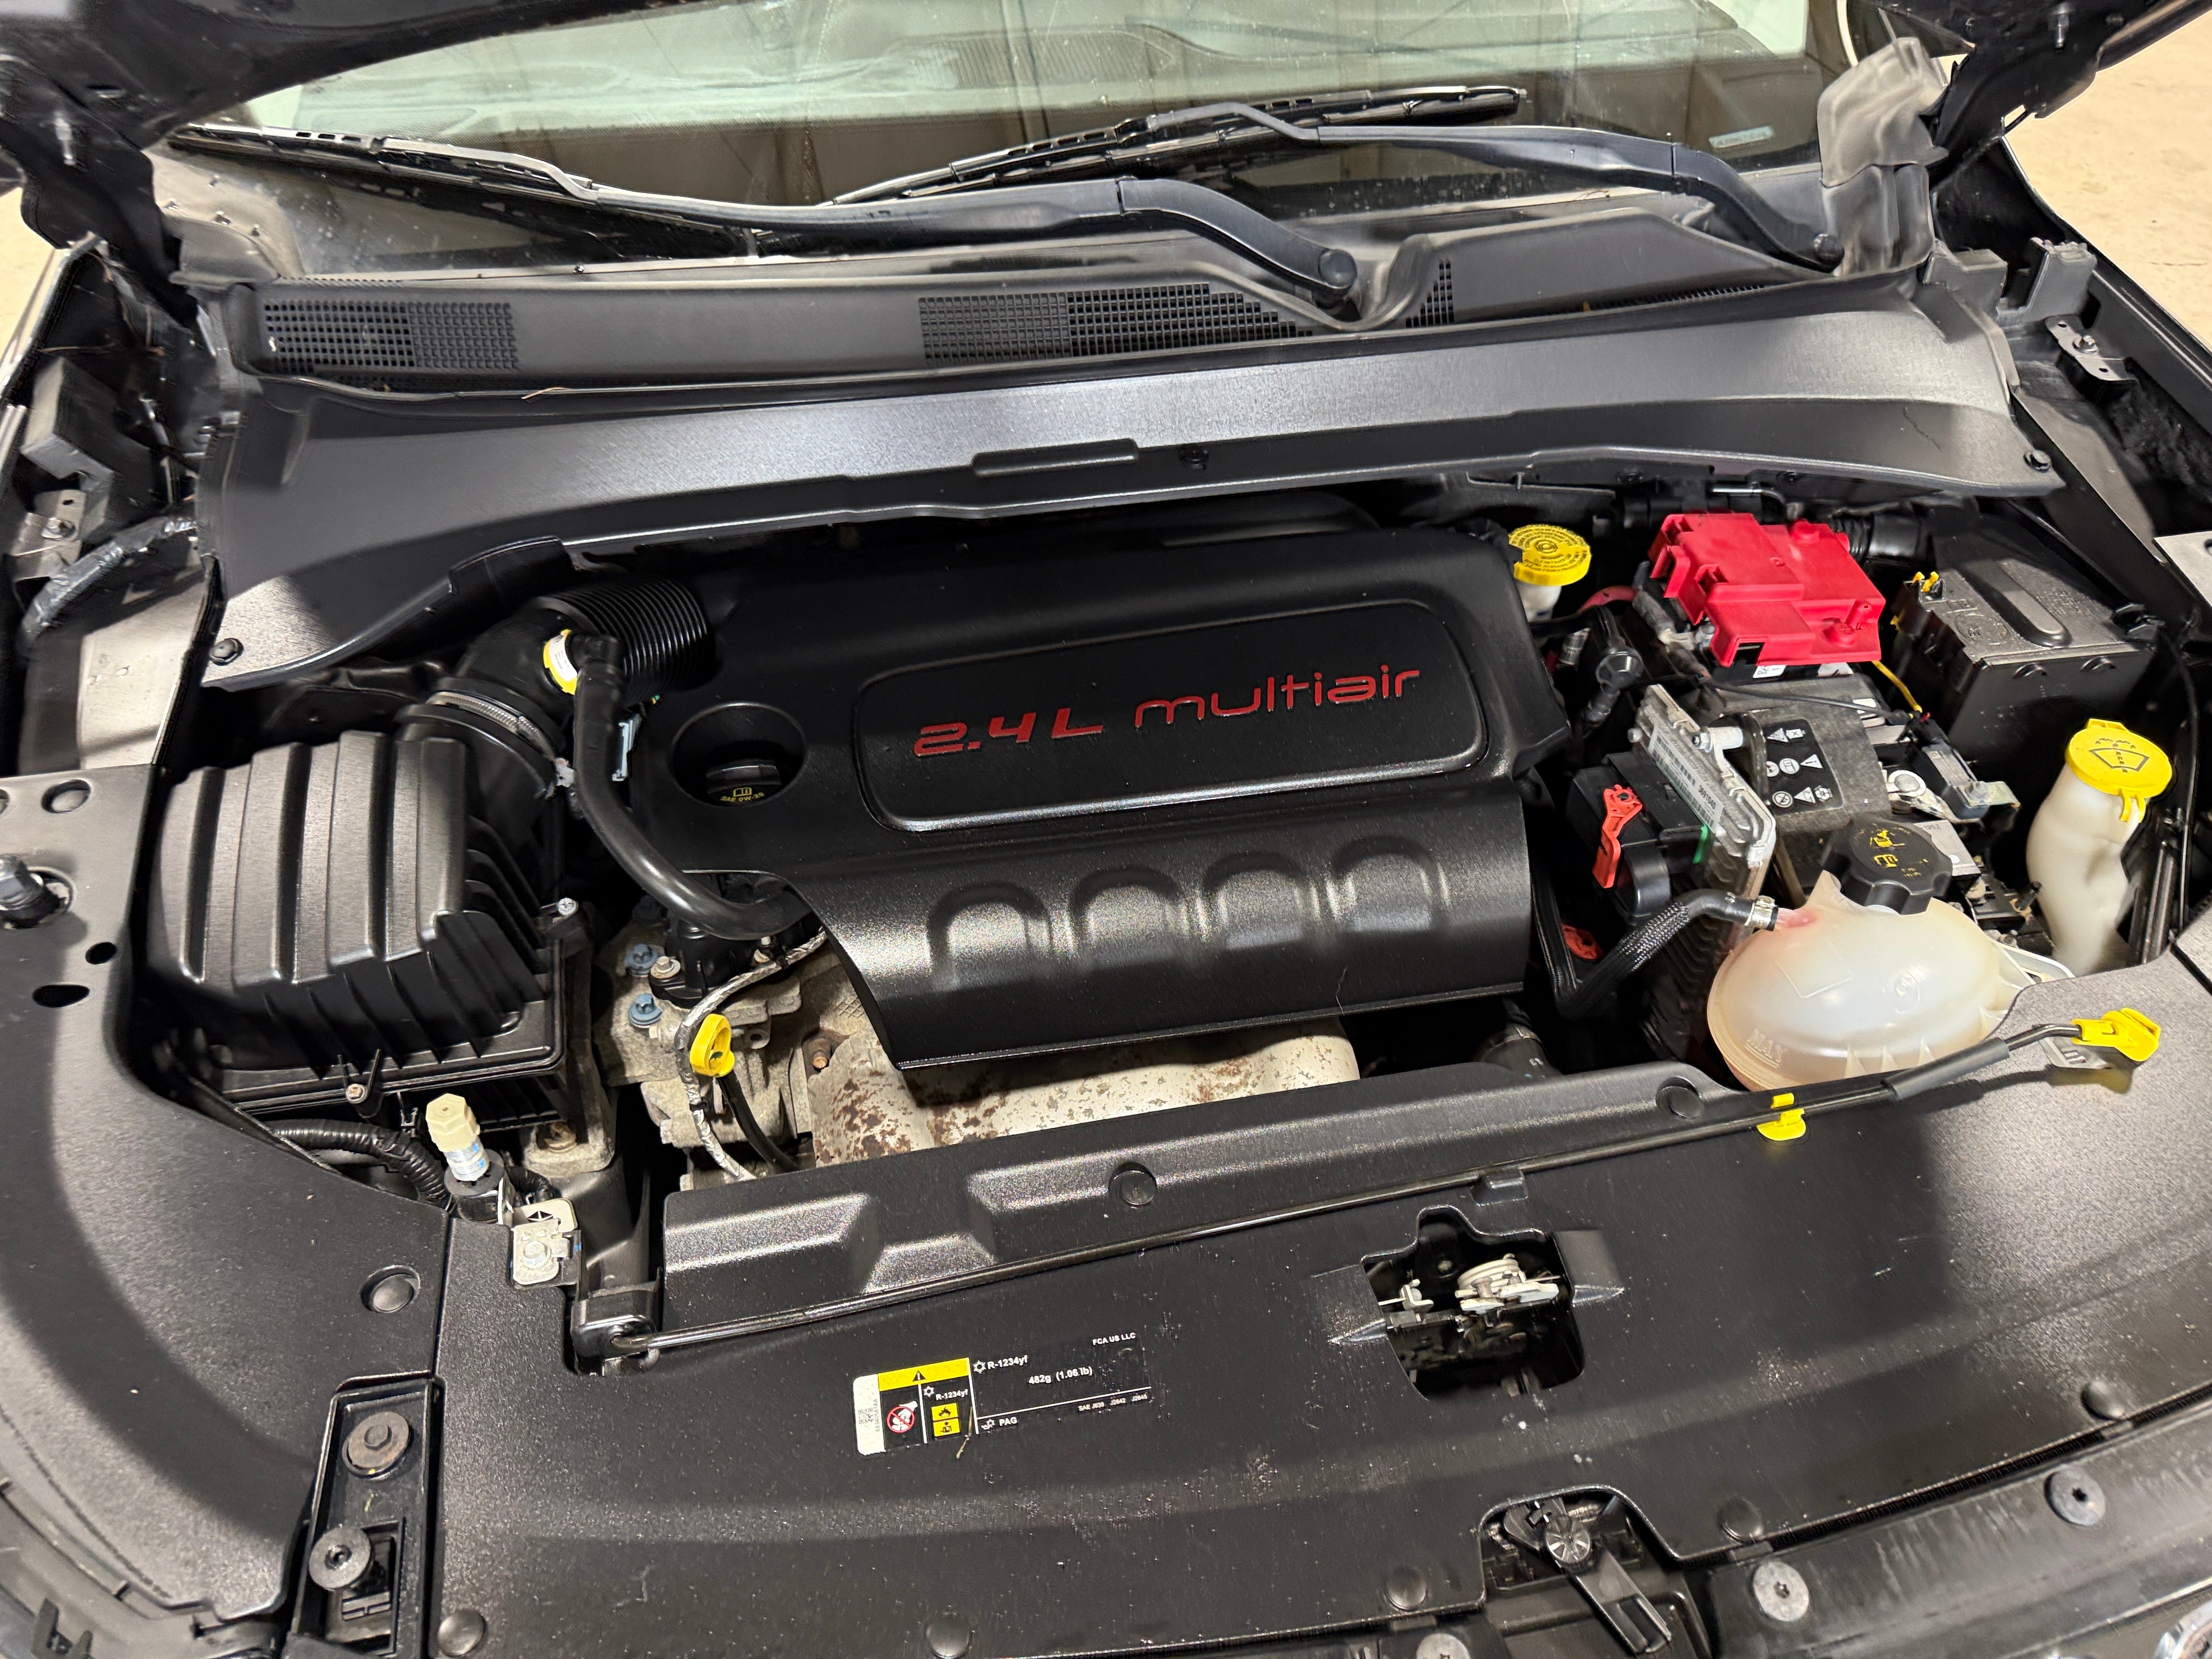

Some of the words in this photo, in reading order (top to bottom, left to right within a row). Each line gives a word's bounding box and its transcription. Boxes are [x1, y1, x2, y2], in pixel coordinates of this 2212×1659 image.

[1134, 664, 1420, 729] multiair
[738, 792, 765, 802] 0W-20
[1121, 1332, 1136, 1340] LLC
[987, 1355, 1028, 1369] R-1234yf
[1029, 1375, 1051, 1385] 482g
[1056, 1369, 1079, 1381] (1.06
[1079, 1366, 1093, 1376] lb)
[935, 1389, 968, 1401] R-1234yf
[999, 1417, 1018, 1426] PAG
